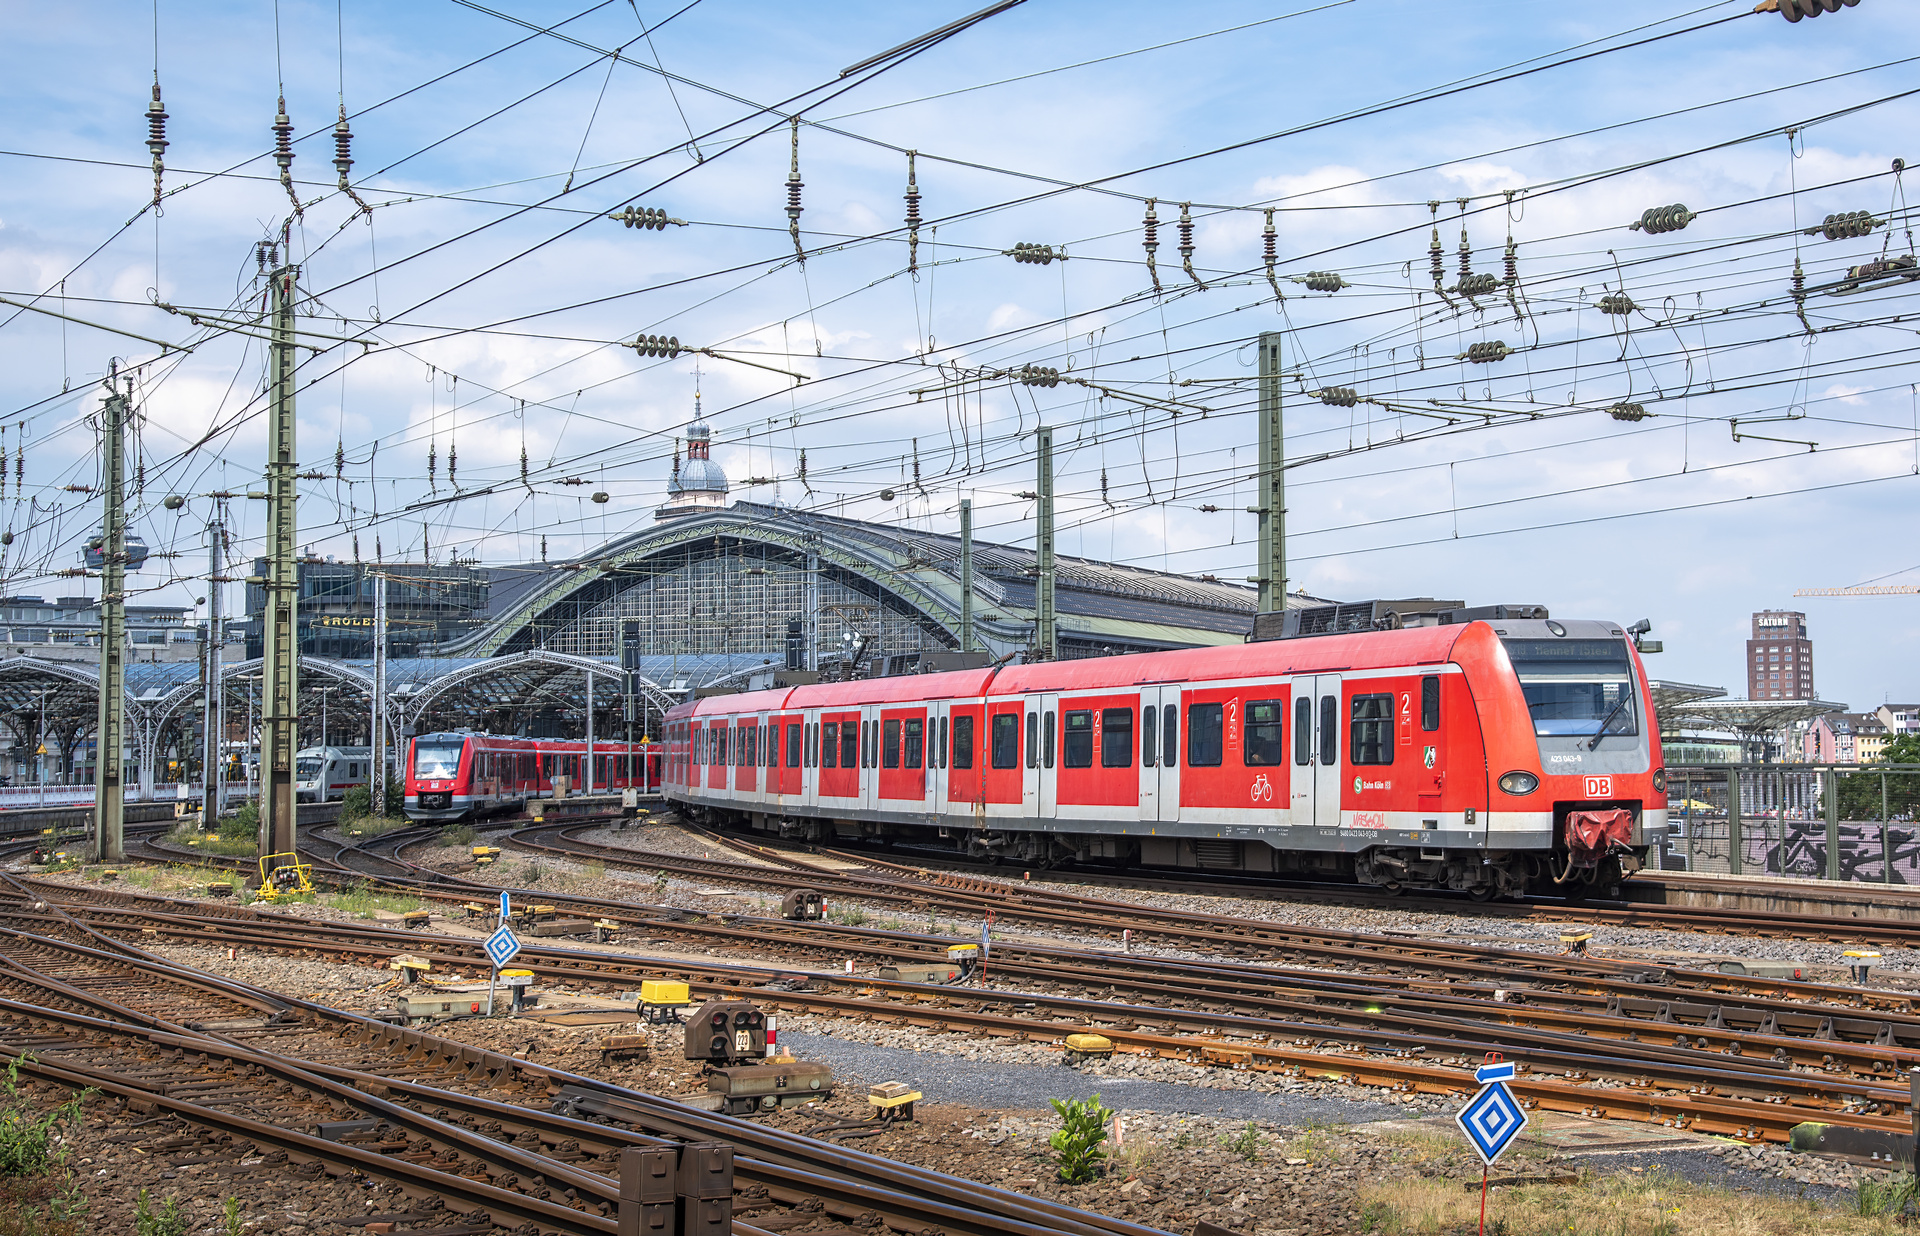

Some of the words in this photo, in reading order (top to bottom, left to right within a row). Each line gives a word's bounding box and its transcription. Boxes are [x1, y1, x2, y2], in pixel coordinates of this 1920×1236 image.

[332, 616, 376, 626] ROLE
[1758, 617, 1788, 627] SATURN
[1535, 644, 1575, 655] Hennef
[1402, 693, 1410, 714] 2
[1094, 710, 1100, 728] 2
[1229, 703, 1236, 722] 2
[1355, 777, 1362, 792] S
[1586, 778, 1610, 796] DB
[737, 1034, 748, 1046] 223
